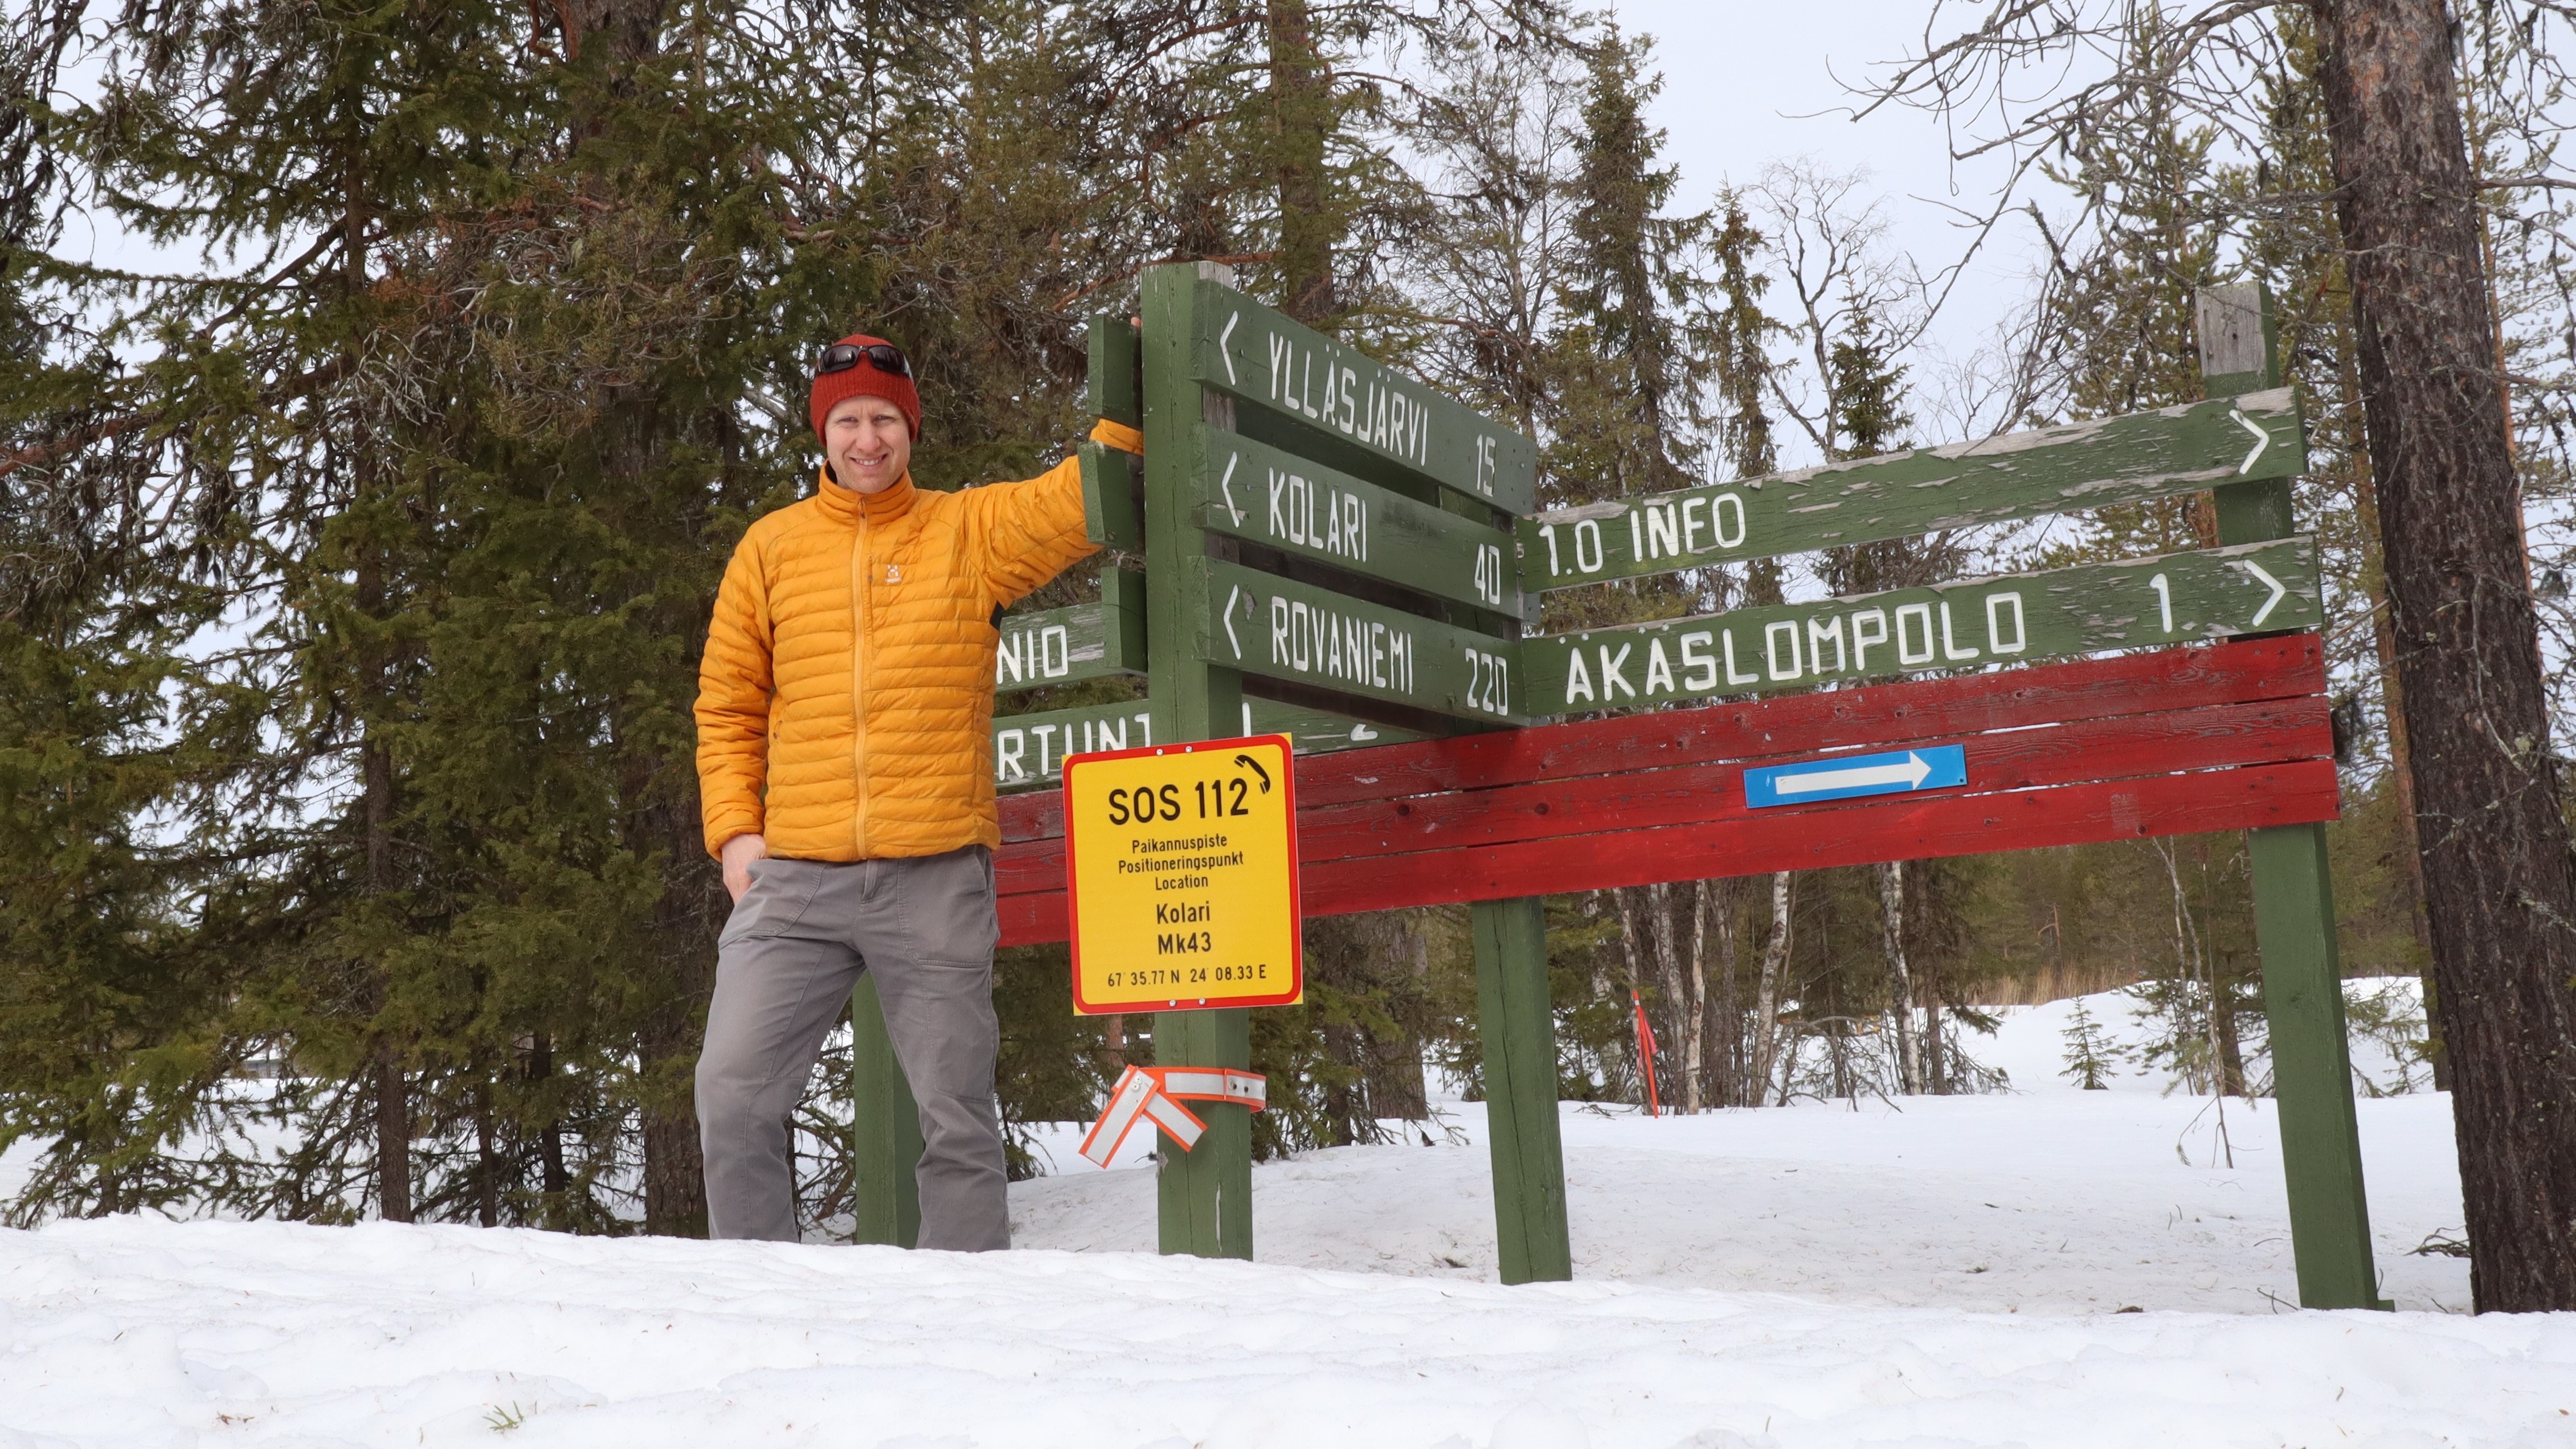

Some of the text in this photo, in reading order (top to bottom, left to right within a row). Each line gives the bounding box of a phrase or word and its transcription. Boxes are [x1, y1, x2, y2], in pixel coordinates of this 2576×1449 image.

[1269, 330, 1497, 498] YLLÄSJÄRVI 15
[1269, 466, 1501, 606] KOLARI 40
[1538, 493, 1746, 577] 1.0 INFO
[1271, 596, 1508, 717] ROVANIEMI 220
[1565, 573, 2173, 705] ÄKÄSLOMPOLO 1
[1109, 777, 1249, 825] SOS 112
[1132, 833, 1228, 854] Paikannuspiste
[1118, 851, 1244, 874] Positioneringspunkt
[1155, 874, 1209, 891] Location
[1156, 900, 1211, 924] Kolari
[1158, 931, 1212, 955] Mk43
[1130, 970, 1165, 986] 35.77
[1171, 969, 1180, 984] N
[1215, 965, 1253, 981] 08.33
[1259, 964, 1267, 979] E
